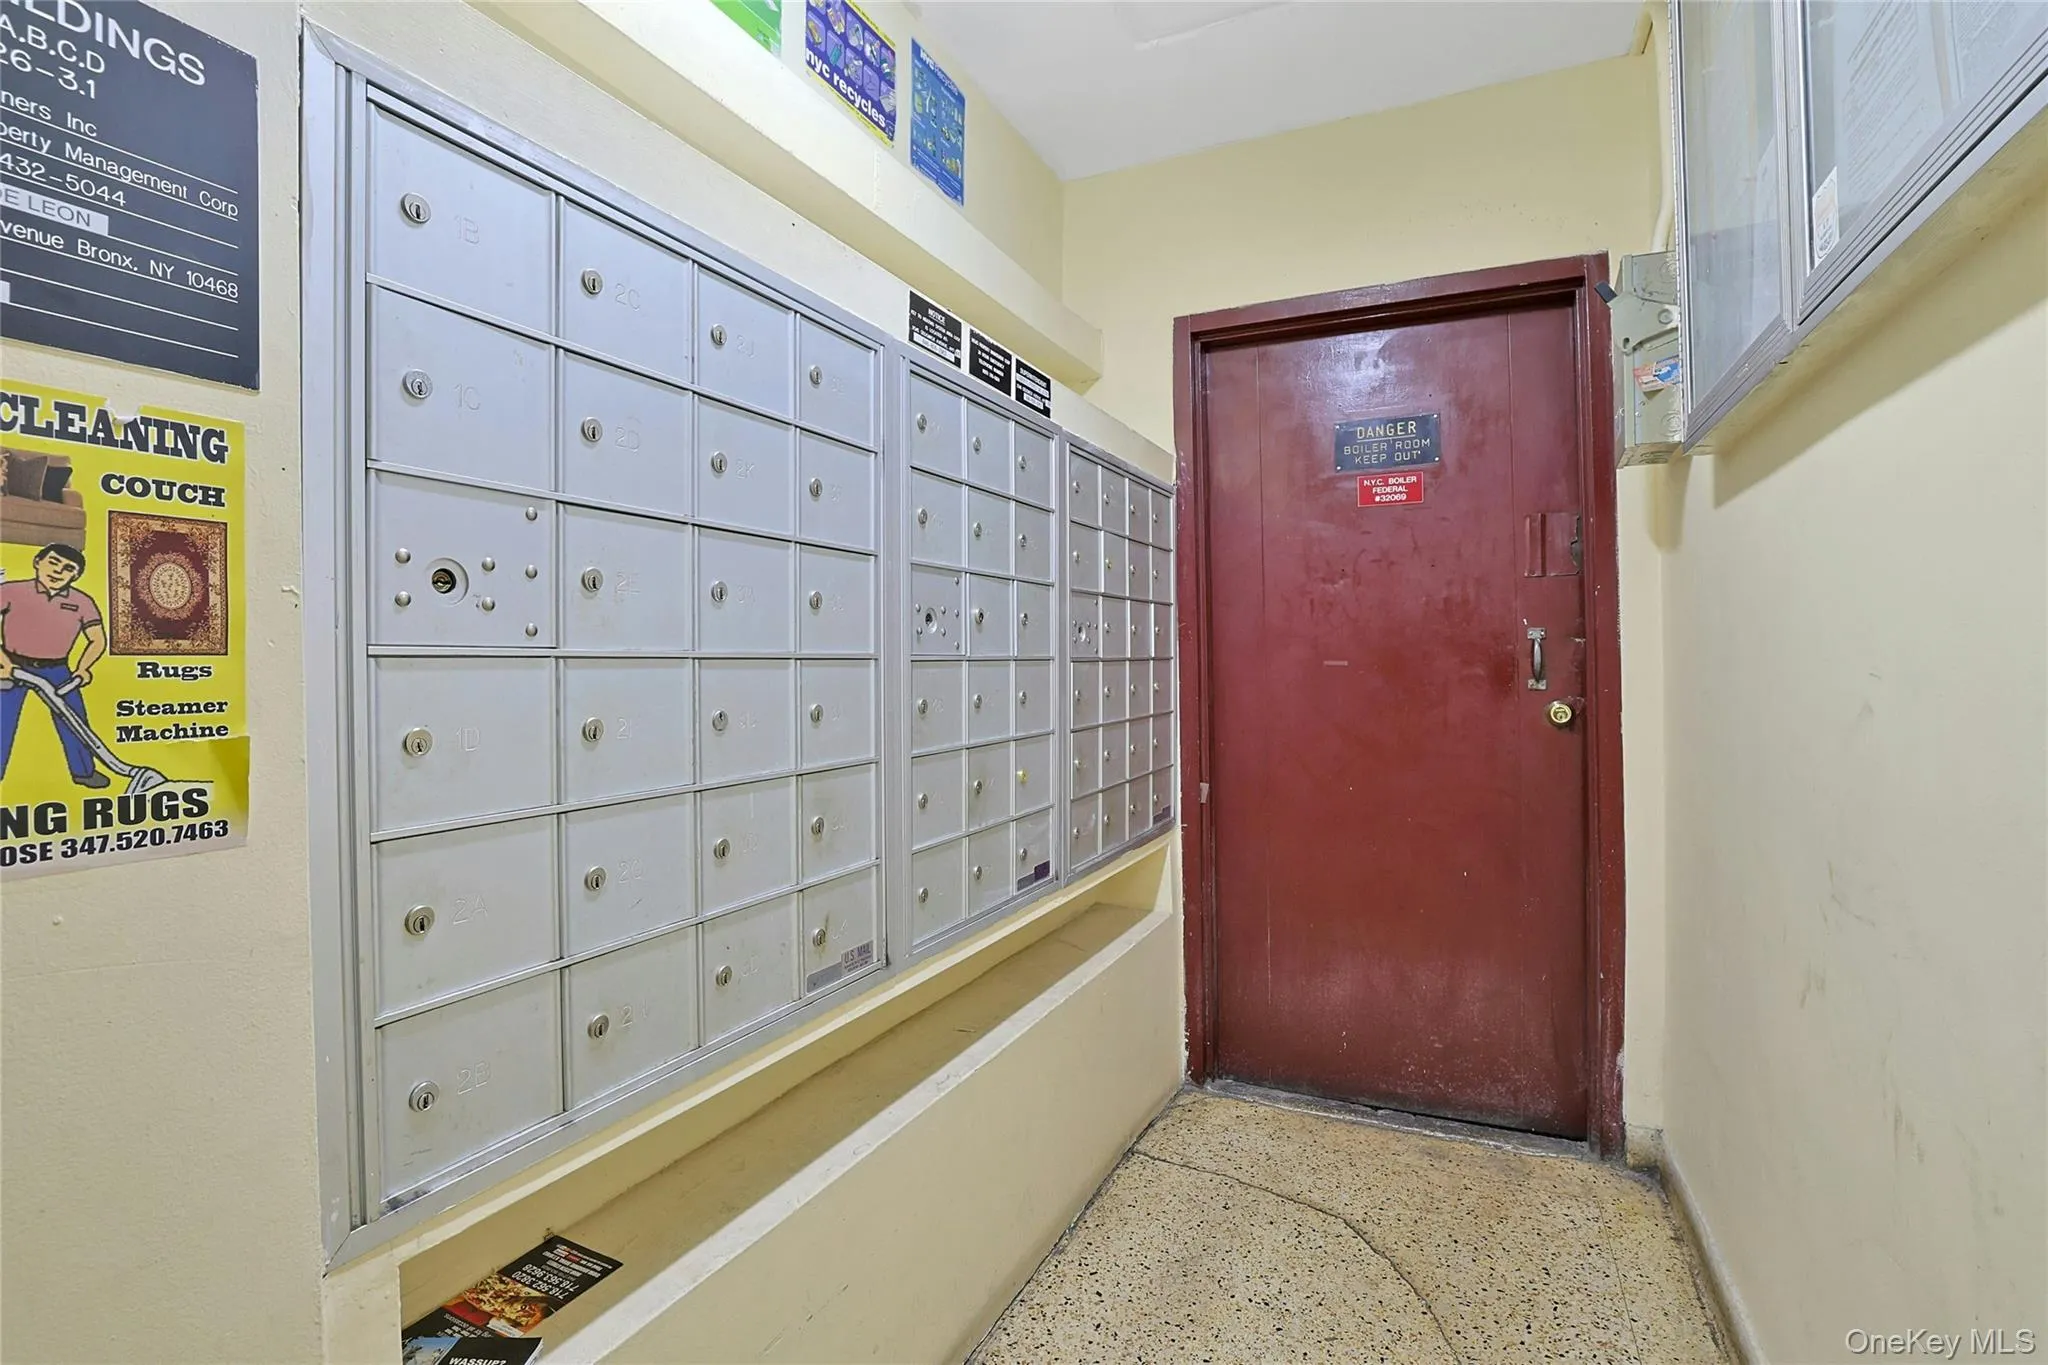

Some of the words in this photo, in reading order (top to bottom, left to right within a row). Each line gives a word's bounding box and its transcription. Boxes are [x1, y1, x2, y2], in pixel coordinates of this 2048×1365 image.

[806, 48, 831, 78] nyc
[833, 73, 886, 127] recycles
[67, 112, 97, 137] Inc
[0, 153, 126, 207] 432-5044
[65, 142, 188, 200] Management
[200, 191, 238, 217] Corp
[28, 195, 91, 228] LEON
[0, 219, 65, 249] venue
[150, 259, 174, 280] NY
[186, 270, 238, 299] 10468
[0, 392, 228, 464] CLEANING
[1356, 421, 1417, 439] DANGER
[1343, 442, 1388, 455] BOILER
[1395, 438, 1431, 450] ROOM
[1355, 453, 1387, 464] KEEP
[1394, 450, 1419, 461] OUT
[101, 473, 226, 508] COUCH
[1372, 485, 1409, 494] FEDERAL
[1388, 475, 1417, 485] BOILER
[137, 662, 213, 681] Rugs
[116, 700, 229, 717] Steamer
[116, 722, 229, 743] Machine
[0, 802, 67, 840] NG
[83, 788, 209, 830] RUGS
[0, 842, 53, 867] OSE
[61, 820, 229, 859] 347.520.7463
